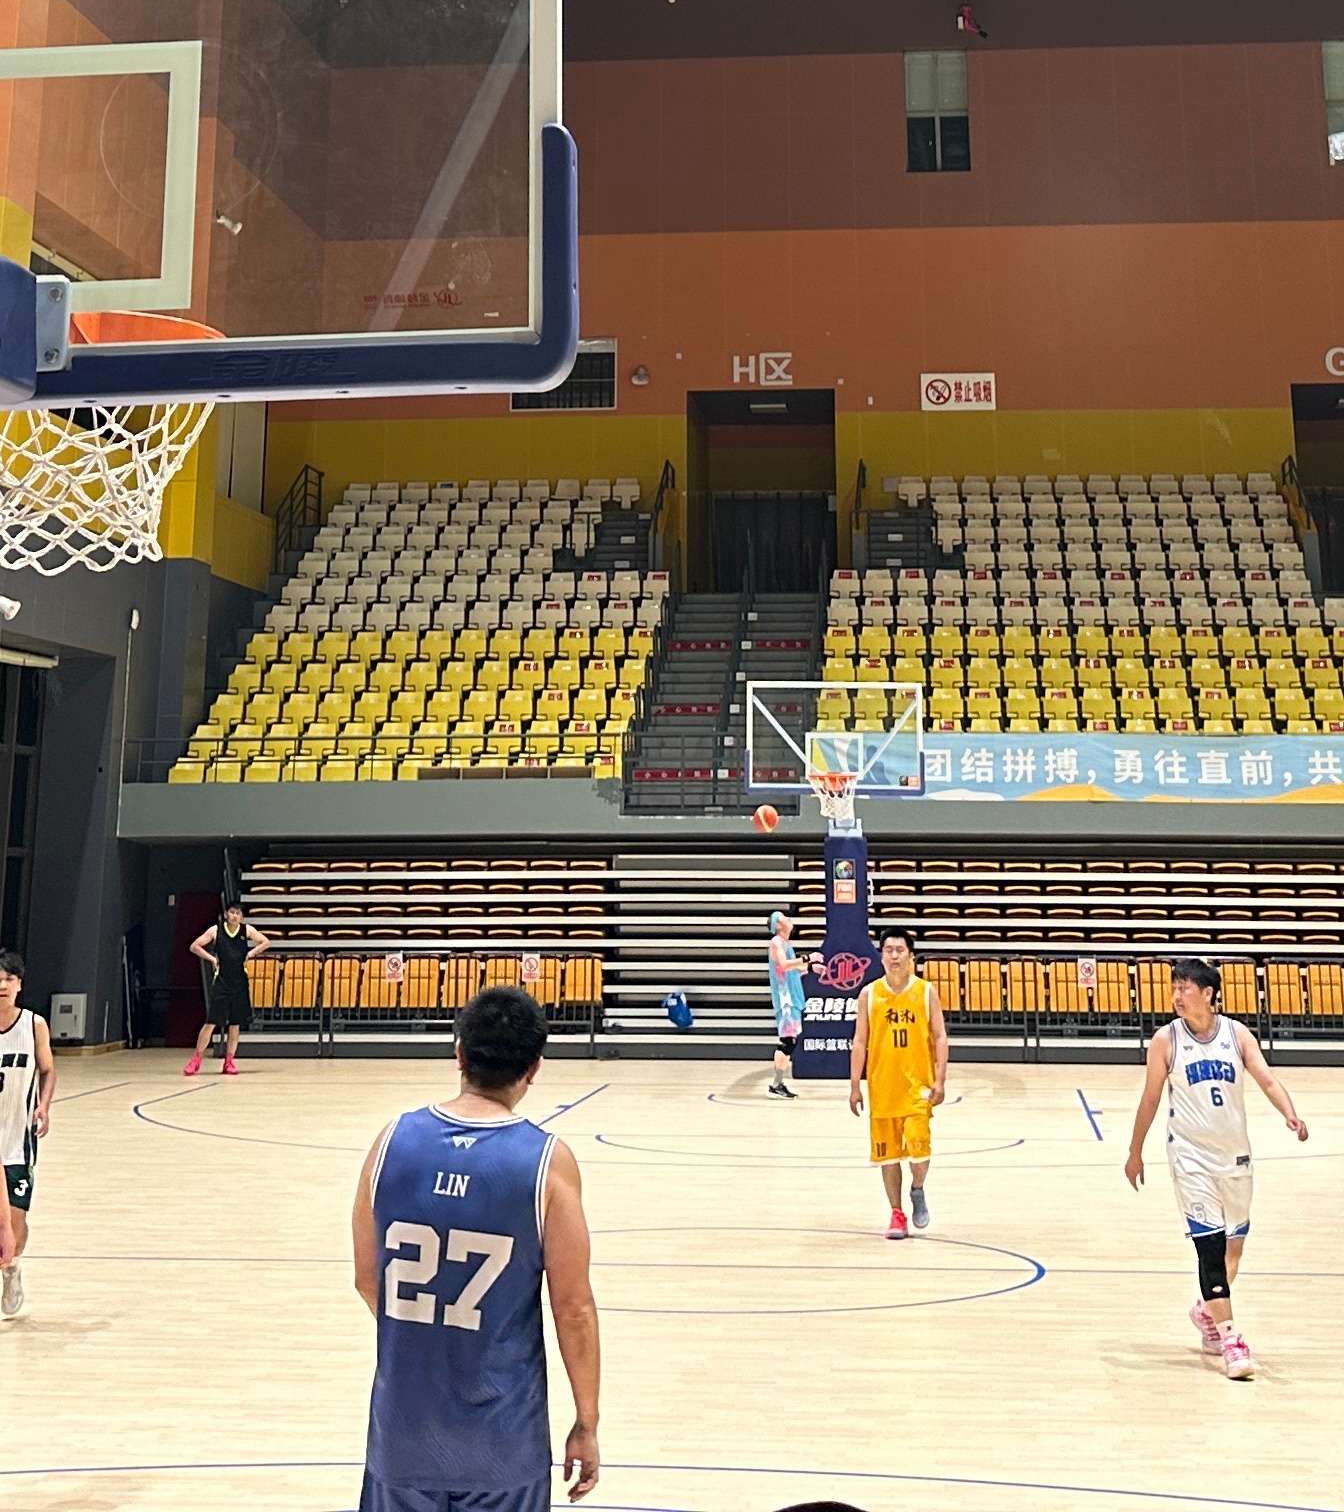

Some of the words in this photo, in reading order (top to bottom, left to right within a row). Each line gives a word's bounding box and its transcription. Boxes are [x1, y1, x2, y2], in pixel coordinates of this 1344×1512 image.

[733, 352, 793, 386] H区
[954, 381, 992, 403] 禁止吸烟
[804, 1038, 853, 1051] 国际篮联
[892, 1028, 908, 1048] 10
[1211, 1087, 1224, 1107] 6
[876, 1142, 887, 1157] 10
[14, 1179, 29, 1197] 3
[433, 1171, 470, 1197] LIN
[385, 1220, 514, 1331] 27
